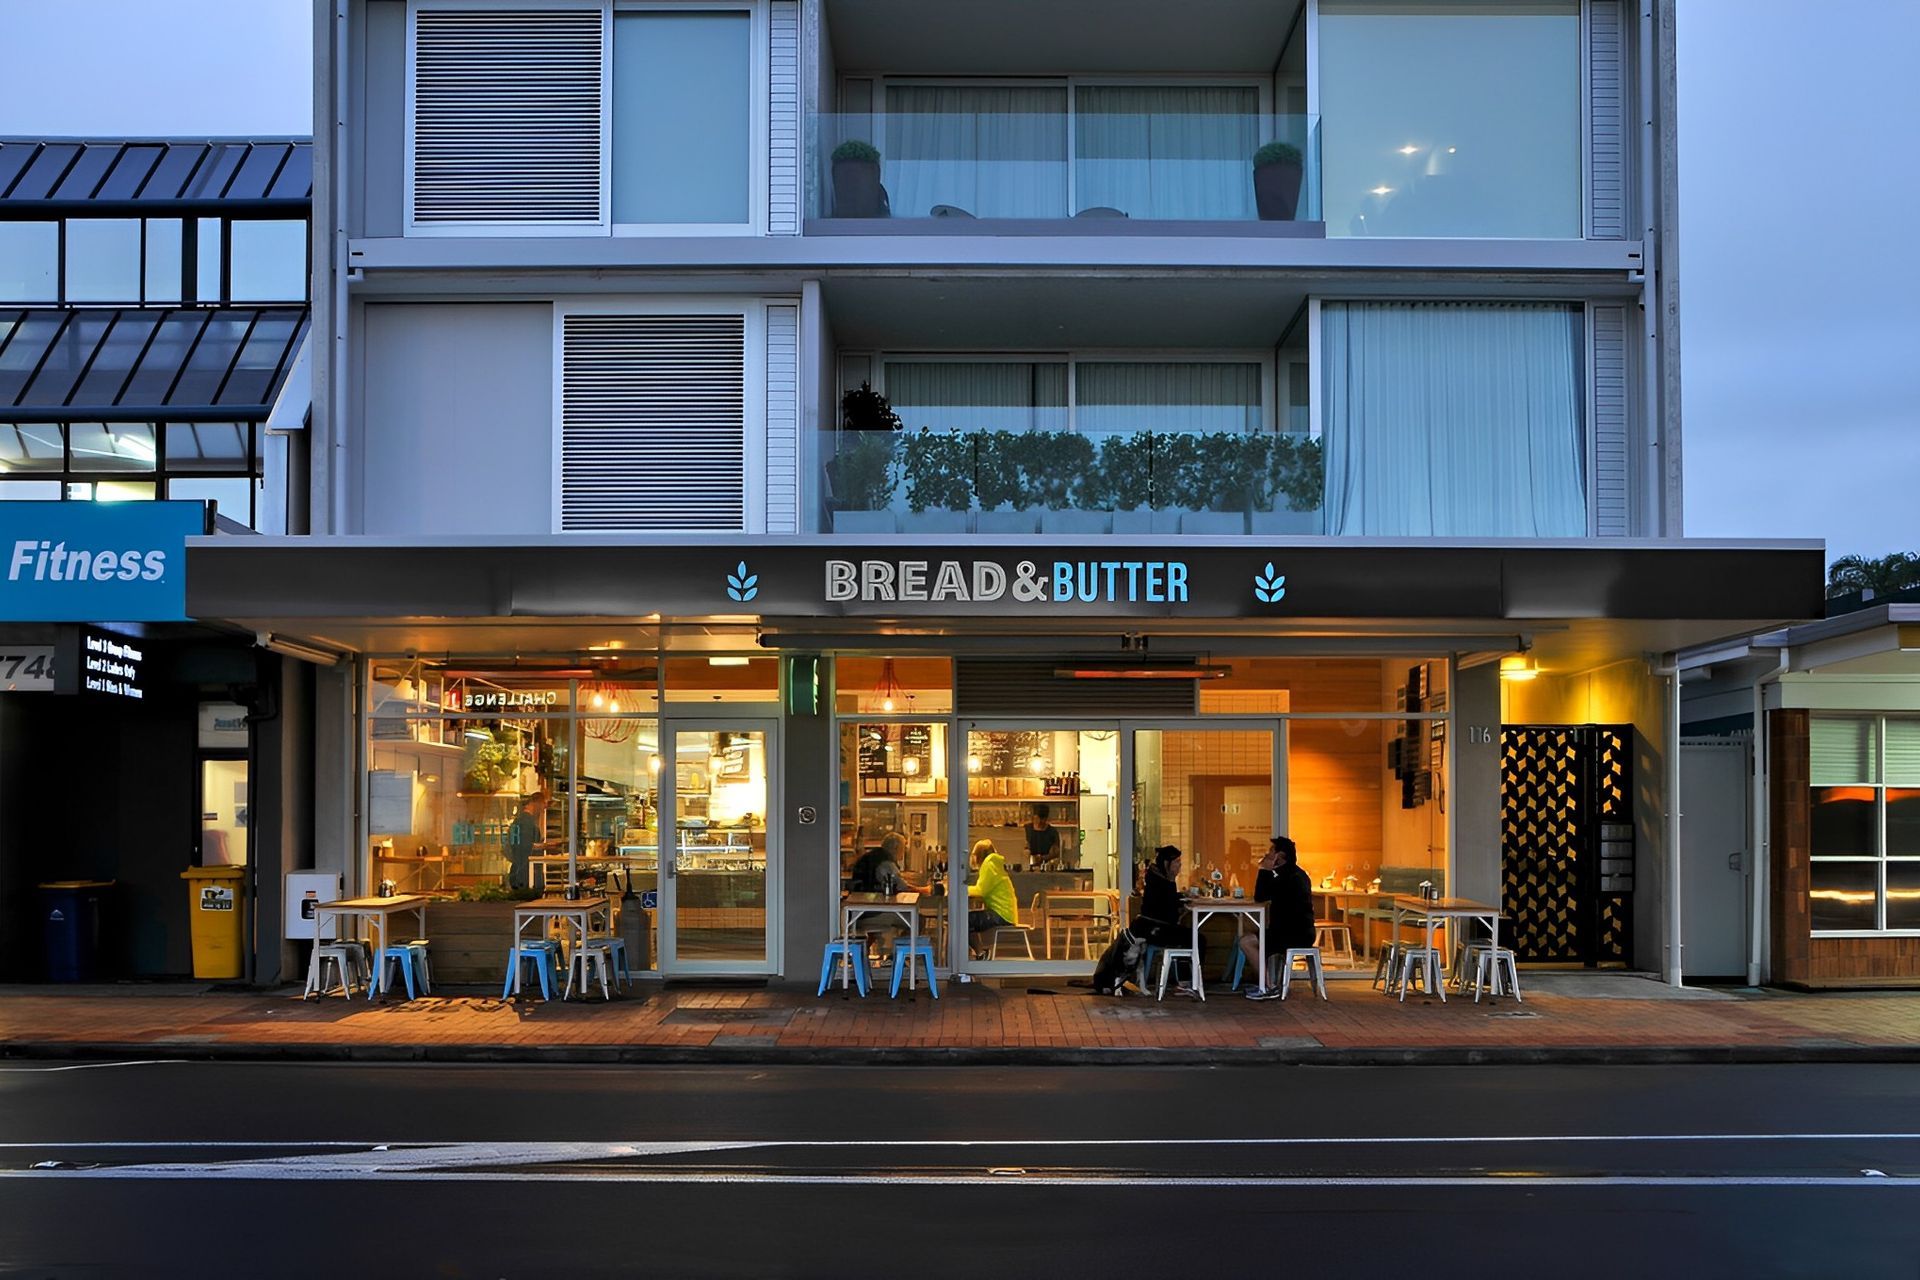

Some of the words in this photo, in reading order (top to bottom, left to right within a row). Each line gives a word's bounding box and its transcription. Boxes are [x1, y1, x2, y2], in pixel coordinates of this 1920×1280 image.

[8, 541, 166, 581] Fitness
[825, 560, 1007, 602] BREAD
[1053, 562, 1189, 602] BUTTER
